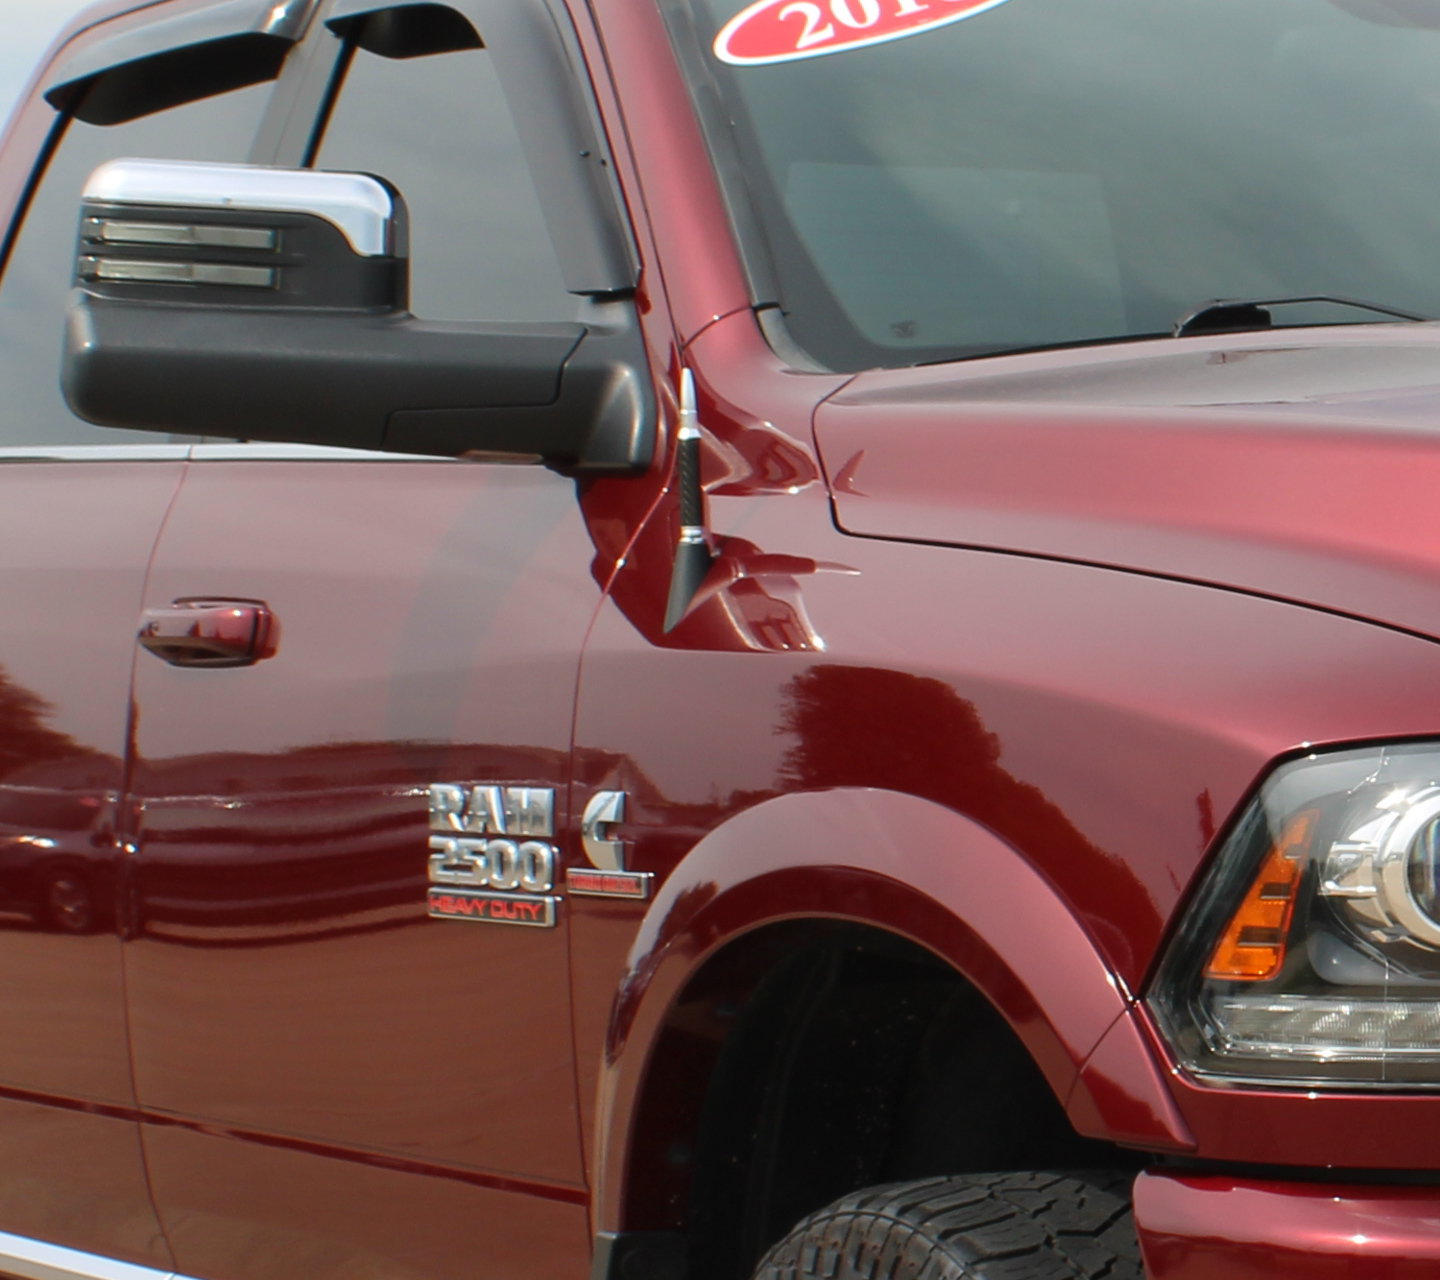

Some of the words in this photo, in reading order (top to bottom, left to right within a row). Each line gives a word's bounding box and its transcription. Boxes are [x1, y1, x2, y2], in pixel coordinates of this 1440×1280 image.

[428, 782, 556, 838] RAM
[427, 835, 554, 893] 2500
[428, 895, 487, 917] HEAVY
[490, 899, 542, 921] DUTY
